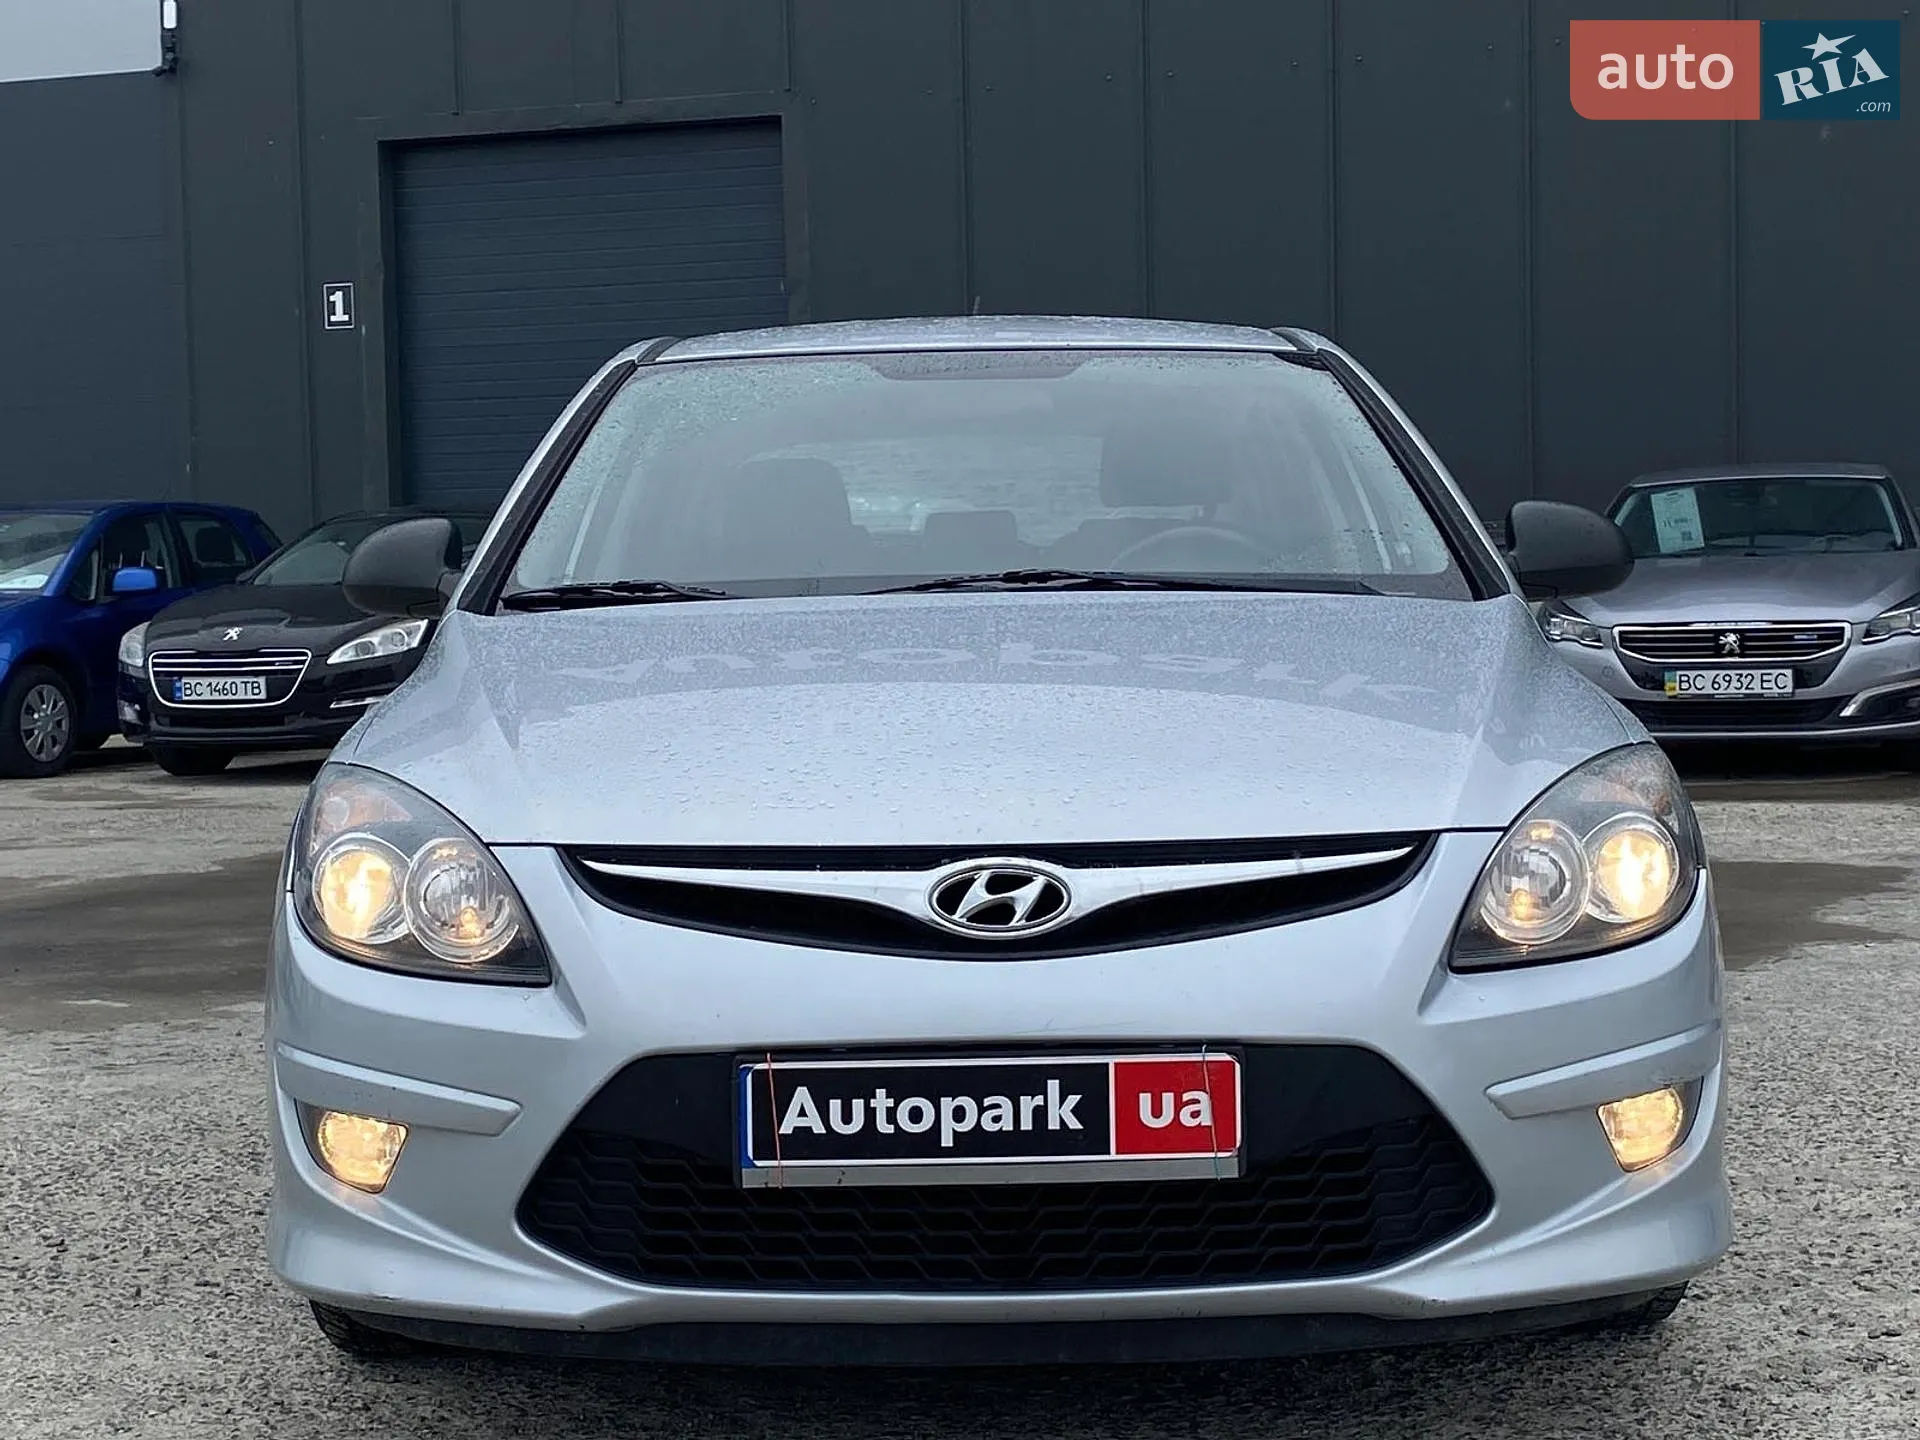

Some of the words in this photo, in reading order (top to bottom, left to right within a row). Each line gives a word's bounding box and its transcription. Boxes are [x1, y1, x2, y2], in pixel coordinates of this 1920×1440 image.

[329, 290, 349, 321] 1
[183, 682, 204, 697] BC
[206, 681, 238, 696] 1460
[240, 681, 262, 696] TB
[1678, 673, 1706, 692] BC
[1711, 672, 1755, 692] 6932
[1760, 672, 1788, 691] EC
[778, 1079, 1084, 1147] Autopark
[1139, 1089, 1213, 1128] ua
